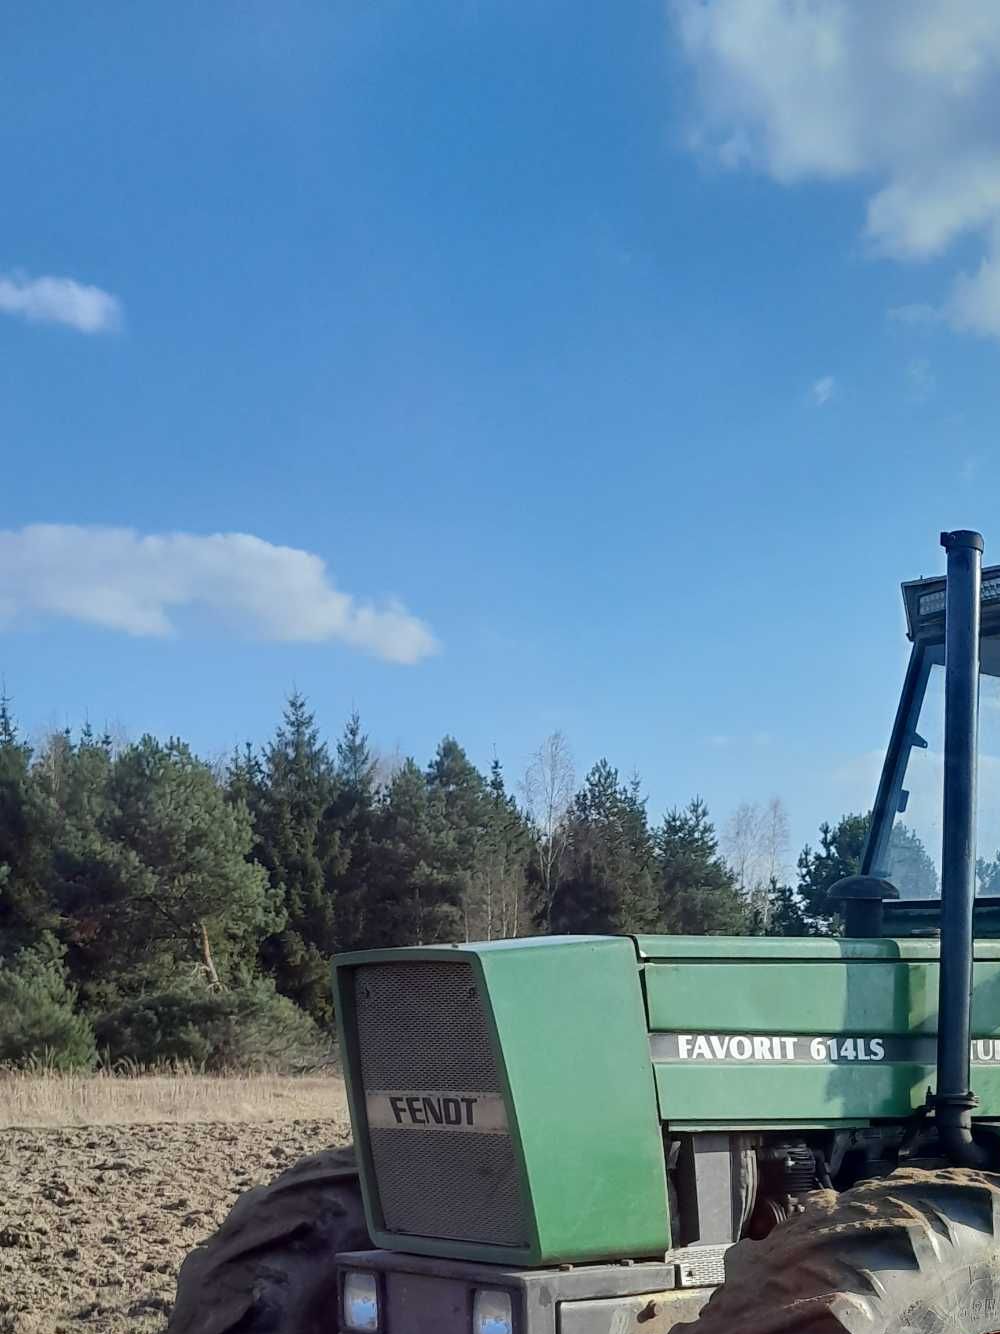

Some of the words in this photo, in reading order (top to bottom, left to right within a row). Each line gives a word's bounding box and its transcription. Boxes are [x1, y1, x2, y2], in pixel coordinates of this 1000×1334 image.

[677, 1034, 798, 1061] FAVORIT
[810, 1036, 885, 1061] 614LS
[389, 1096, 477, 1125] FENDT
